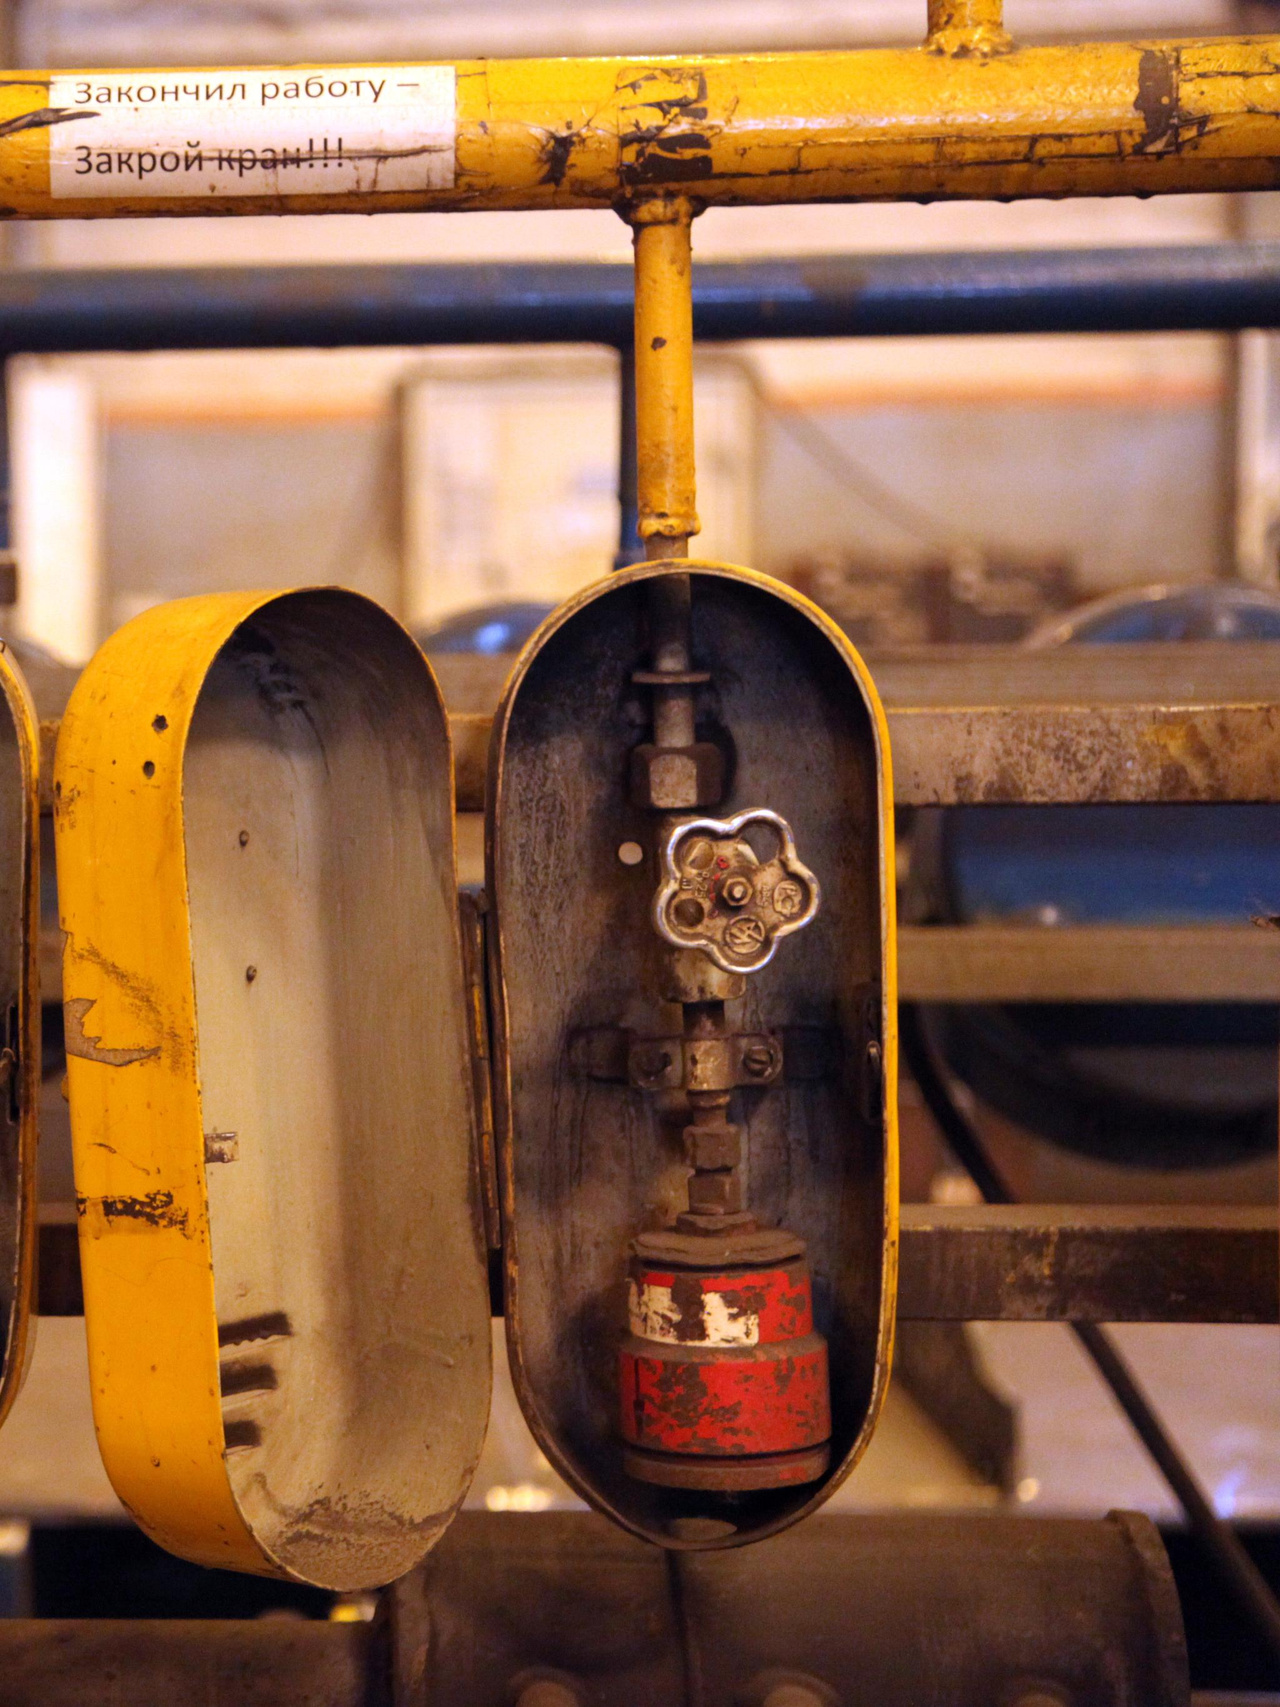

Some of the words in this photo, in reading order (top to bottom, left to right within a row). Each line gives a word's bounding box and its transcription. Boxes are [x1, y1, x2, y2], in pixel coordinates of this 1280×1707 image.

[75, 80, 246, 104] Закончил
[261, 75, 386, 106] работу
[75, 141, 204, 179] Закрой
[217, 137, 344, 177] кран!!!
